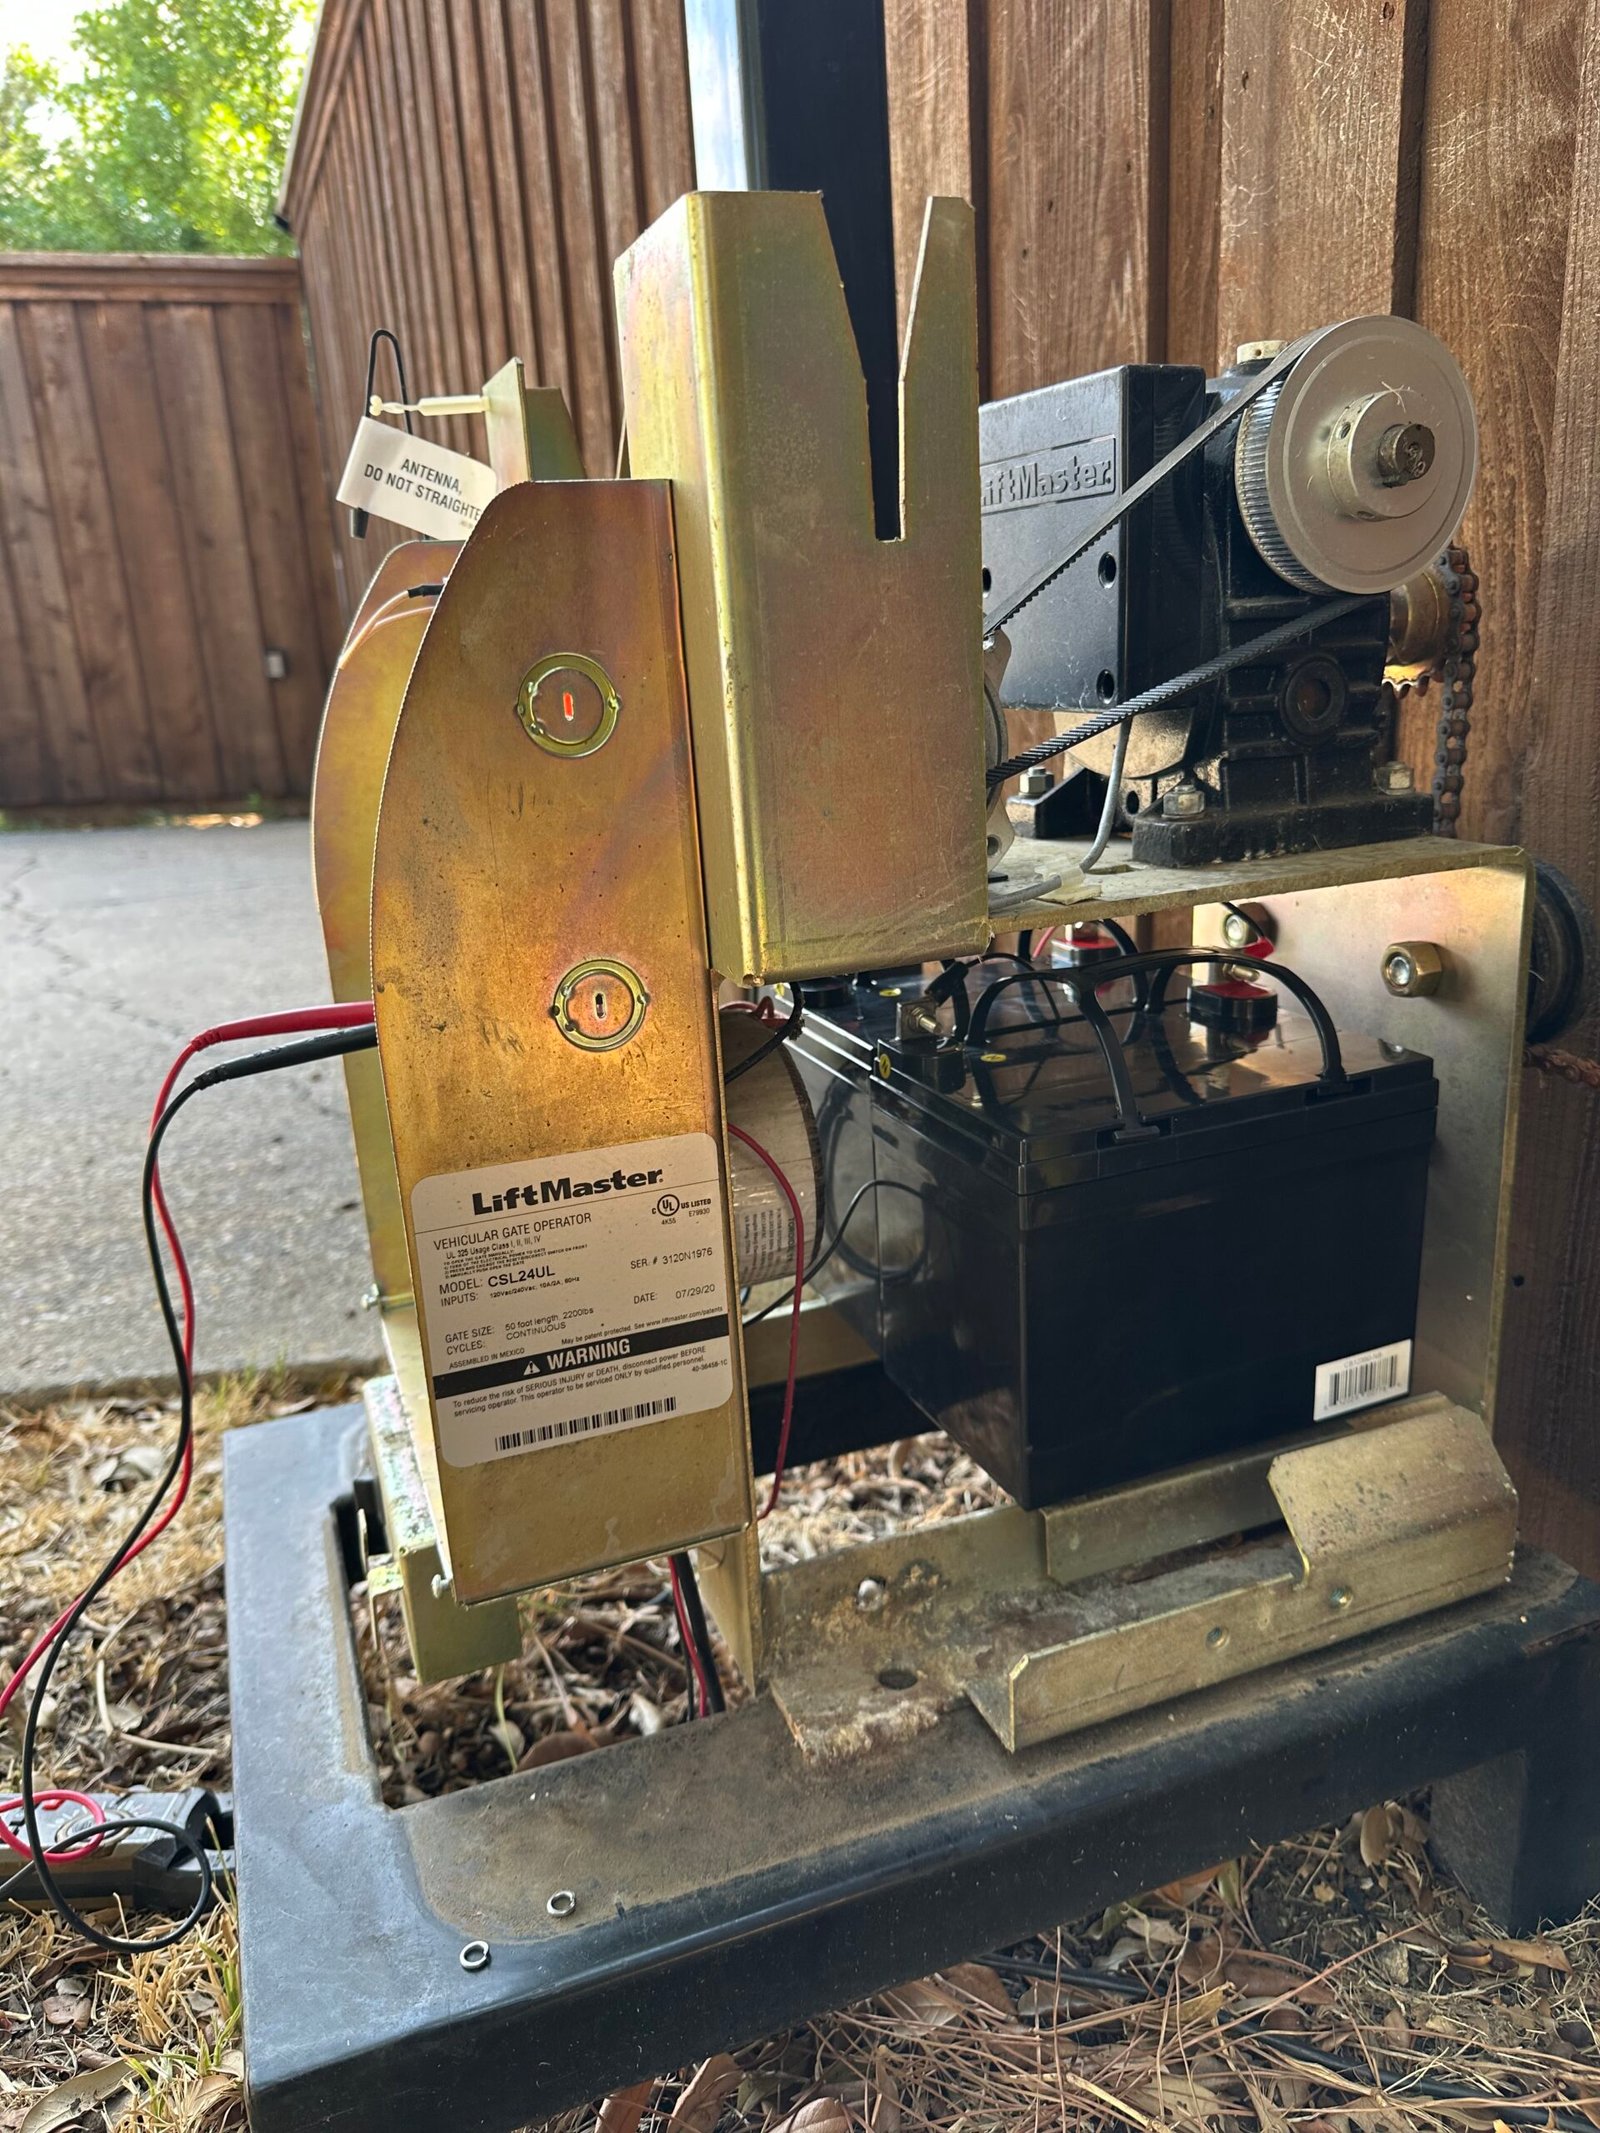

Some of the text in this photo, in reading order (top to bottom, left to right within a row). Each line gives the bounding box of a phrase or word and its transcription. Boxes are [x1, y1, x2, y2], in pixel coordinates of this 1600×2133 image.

[364, 464, 482, 520] DO NOT STRAIGHTE
[401, 458, 462, 495] ANTENNA,
[681, 1201, 690, 1209] US
[691, 1198, 712, 1208] LISTED
[433, 1212, 592, 1251] VEHICULAR GATE OPERATOR
[446, 1251, 456, 1260] UL
[457, 1249, 469, 1258] 325
[470, 1246, 490, 1257] Usage
[492, 1242, 510, 1252] Class
[534, 1235, 542, 1243] IV
[662, 1247, 713, 1264] 3120N1976
[439, 1265, 556, 1295] MODEL: CSL24UL
[676, 1284, 716, 1299] 07/29/20
[440, 1293, 479, 1307] INPUTS:
[445, 1330, 470, 1343] GATE
[472, 1325, 495, 1338] SIZE:
[505, 1322, 516, 1331] 50
[518, 1320, 533, 1328] foot
[563, 1307, 594, 1320] 2200lbs
[446, 1322, 566, 1355] CYCLES: CONTINUOUS
[584, 1332, 602, 1342] patent
[634, 1322, 644, 1330] See
[448, 1355, 489, 1370] ASSEMBLED
[500, 1348, 525, 1358] MEXICO
[547, 1338, 630, 1370] WARNING
[453, 1400, 462, 1408] To
[464, 1396, 488, 1405] reduce
[489, 1392, 500, 1400] the
[526, 1379, 558, 1392] SERIOUS
[560, 1372, 585, 1384] INJURY
[596, 1366, 620, 1377] DEATH,
[622, 1358, 658, 1370] disconnect
[659, 1353, 678, 1363] power
[680, 1346, 706, 1358] BEFORE
[454, 1405, 486, 1417] servicing
[520, 1394, 534, 1402] This
[537, 1386, 565, 1398] operator
[567, 1384, 574, 1392] to
[586, 1376, 612, 1388] serviced
[614, 1370, 632, 1381] ONLY
[634, 1368, 642, 1377] by
[644, 1362, 671, 1375] qualified
